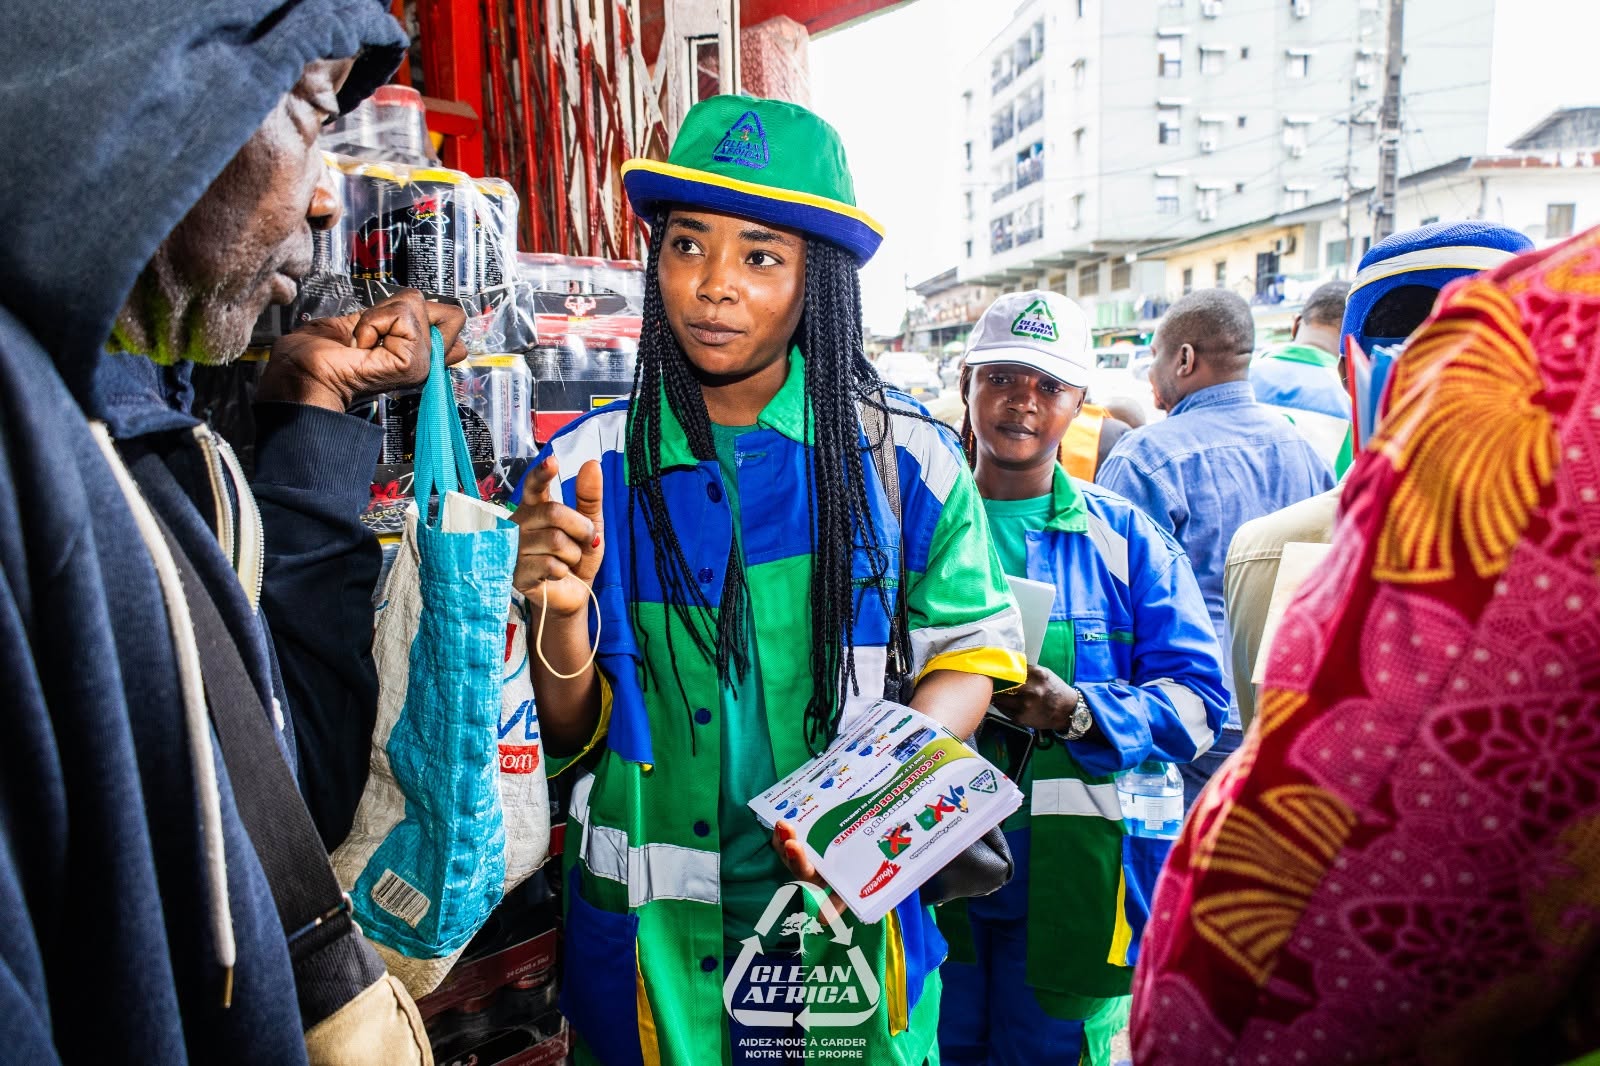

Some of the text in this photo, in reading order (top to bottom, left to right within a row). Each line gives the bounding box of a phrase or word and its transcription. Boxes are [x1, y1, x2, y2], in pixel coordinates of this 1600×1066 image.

[1016, 325, 1053, 336] AFRICA
[1019, 319, 1053, 330] CLEAN
[931, 749, 945, 761] LA
[892, 759, 933, 795] COLLECTE
[908, 774, 935, 796] Nous
[866, 772, 903, 803] ARRONDISSEMENT
[879, 793, 893, 806] DE
[838, 807, 861, 826] LIBREVILLE
[870, 793, 910, 828] passons
[863, 864, 895, 896] Nouveau
[514, 963, 532, 975] CANS
